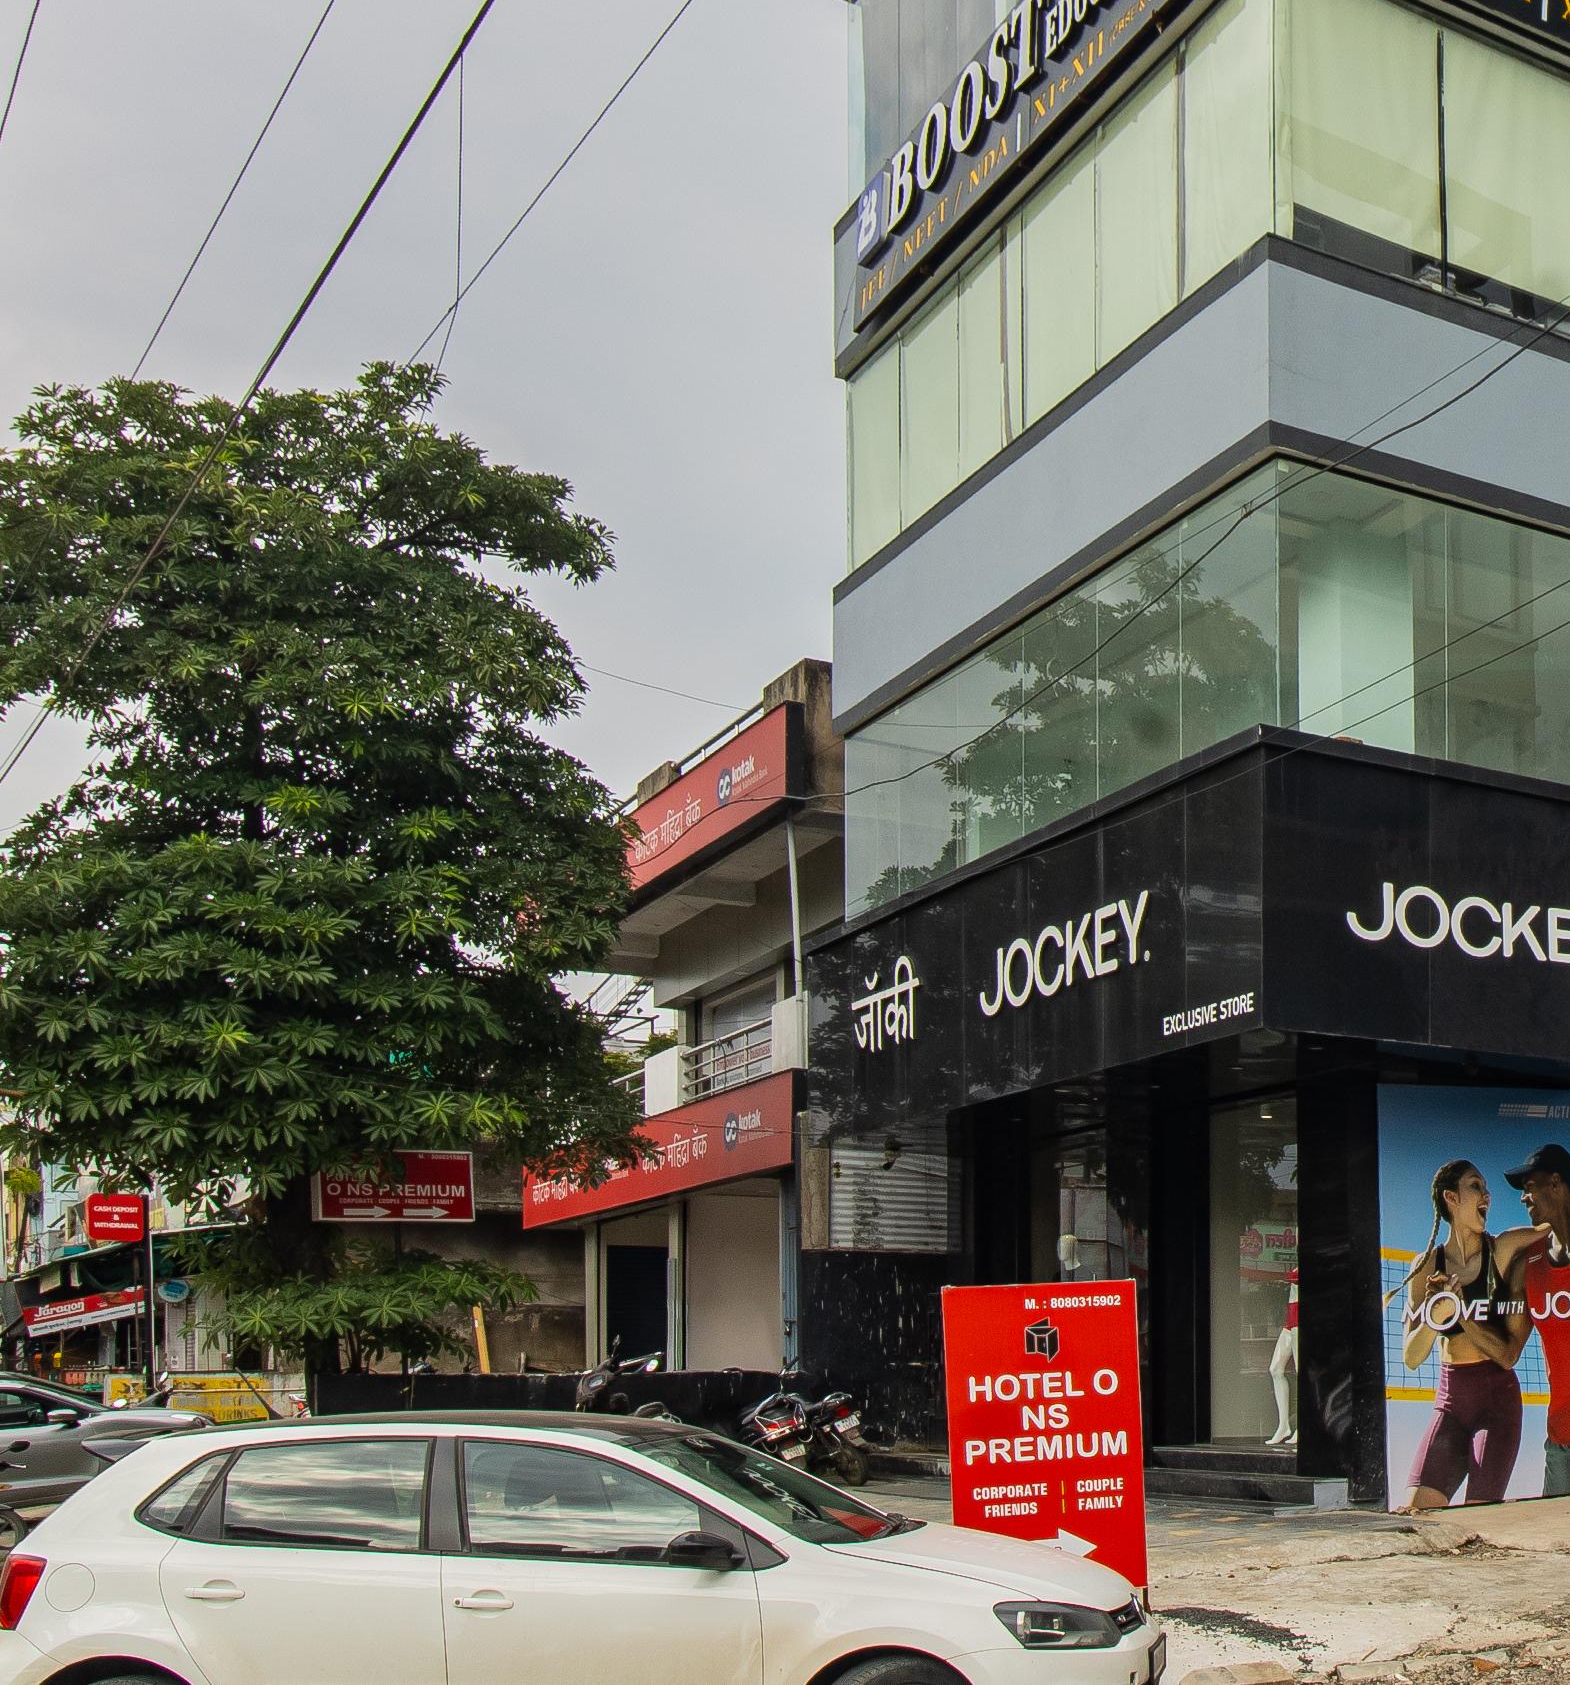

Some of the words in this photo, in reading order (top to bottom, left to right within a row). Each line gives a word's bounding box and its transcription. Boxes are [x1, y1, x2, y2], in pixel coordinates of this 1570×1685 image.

[861, 266, 887, 314] JEE
[904, 197, 948, 262] NEET
[969, 135, 1008, 193] NDA
[732, 754, 755, 785] kotak
[980, 890, 1149, 1016] JOCKEY
[851, 956, 920, 1053] जॉकी
[1163, 1003, 1217, 1035] EXCLUSIVE
[1219, 992, 1254, 1019] STORE
[739, 1109, 761, 1130] kotak
[327, 1184, 341, 1196] O
[347, 1184, 373, 1196] NS
[94, 1221, 139, 1229] WITHDRAWAL
[1025, 1298, 1039, 1310] M.
[1050, 1295, 1121, 1308] 8080315902
[1401, 1291, 1490, 1331] MOVE
[1497, 1300, 1525, 1315] WITH
[968, 1372, 1084, 1403] HOTEL
[1093, 1369, 1118, 1395] O
[1021, 1404, 1069, 1431] NS
[965, 1431, 1128, 1466] PREMIUM
[973, 1483, 1047, 1501] CORPORATE
[1077, 1478, 1124, 1493] COUPLE
[985, 1502, 1038, 1518] FRIENDS
[1078, 1495, 1124, 1511] FAMILY
